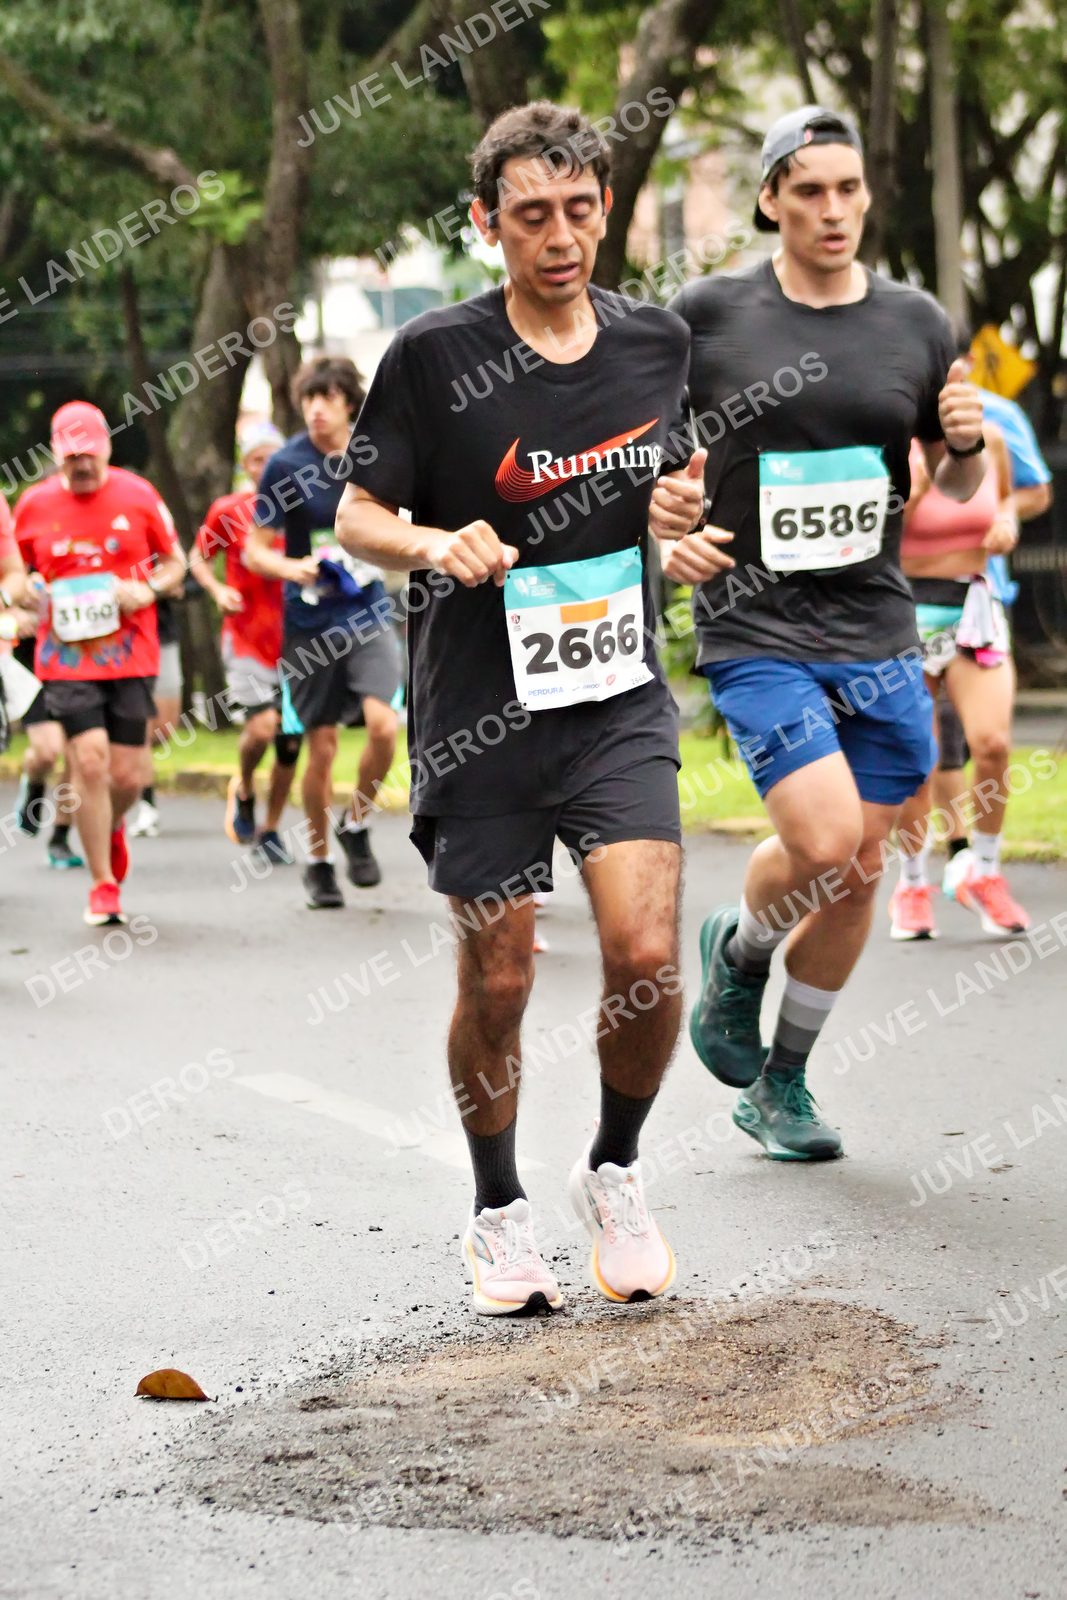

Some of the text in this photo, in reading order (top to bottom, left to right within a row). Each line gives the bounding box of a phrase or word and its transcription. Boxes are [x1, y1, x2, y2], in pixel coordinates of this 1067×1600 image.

[527, 437, 662, 484] Running
[772, 501, 878, 541] 6586
[521, 614, 638, 675] 2666
[528, 686, 565, 697] PERDURA
